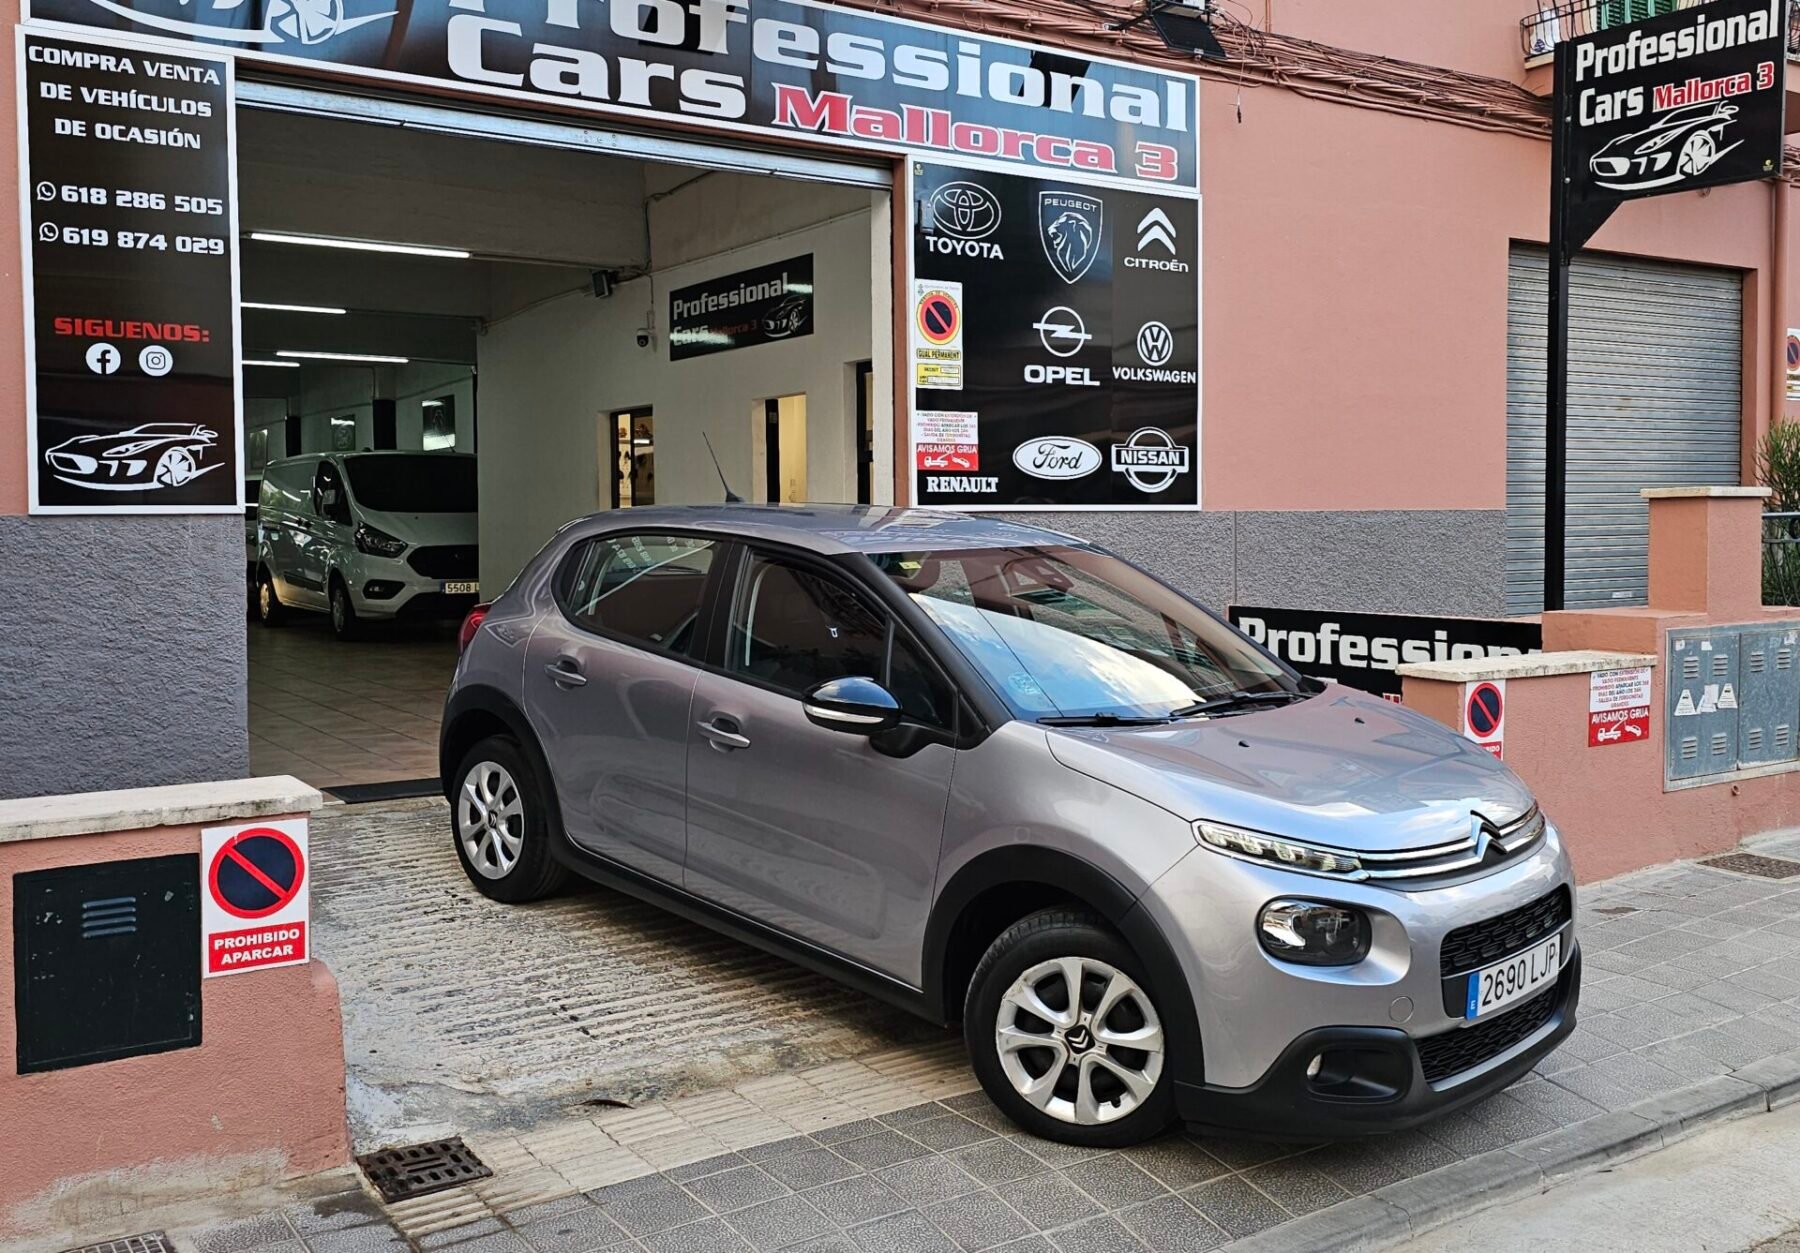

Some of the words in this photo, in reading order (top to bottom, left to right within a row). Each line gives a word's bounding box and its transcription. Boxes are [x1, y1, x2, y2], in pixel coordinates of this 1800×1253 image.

[1576, 0, 1779, 82] Professional
[28, 45, 136, 75] COMPRA
[143, 60, 221, 85] VENTA
[447, 0, 1189, 132] ofessional
[40, 82, 72, 101] DE
[80, 86, 212, 118] VEHÍCULOS
[447, 14, 747, 119] Cars
[771, 82, 1118, 174] Mallorca
[1133, 140, 1179, 181] 3
[1579, 86, 1644, 127] Cars
[1653, 71, 1752, 113] Mallorca
[1756, 61, 1775, 91] 3
[54, 118, 87, 137] DE
[94, 122, 201, 149] OCASIÓN
[61, 185, 108, 206] 618
[115, 190, 167, 210] 286
[174, 196, 224, 216] 505
[1044, 198, 1098, 213] PEUGEOT
[62, 227, 109, 247] 619
[117, 232, 168, 252] 874
[175, 236, 225, 255] 029
[925, 236, 1005, 260] TOYOTA
[673, 271, 788, 321] Professional
[54, 317, 210, 343] SIGUENOS:
[1024, 364, 1101, 386] OPEL
[1112, 367, 1197, 383] VOLKSWAGEN
[917, 445, 955, 453] AVISAMOS
[957, 445, 977, 454] GRUA
[1032, 443, 1082, 471] Ford
[1121, 450, 1180, 465] NISSAN
[926, 476, 999, 493] RENAULT
[447, 583, 472, 593] 5508
[1592, 710, 1628, 724] AVISAMOS
[1630, 707, 1649, 719] GRUA
[213, 928, 300, 950] PROHIBIDO
[221, 944, 294, 966] APARCAR
[1482, 959, 1526, 1006] 2690
[1531, 942, 1556, 984] LJP
